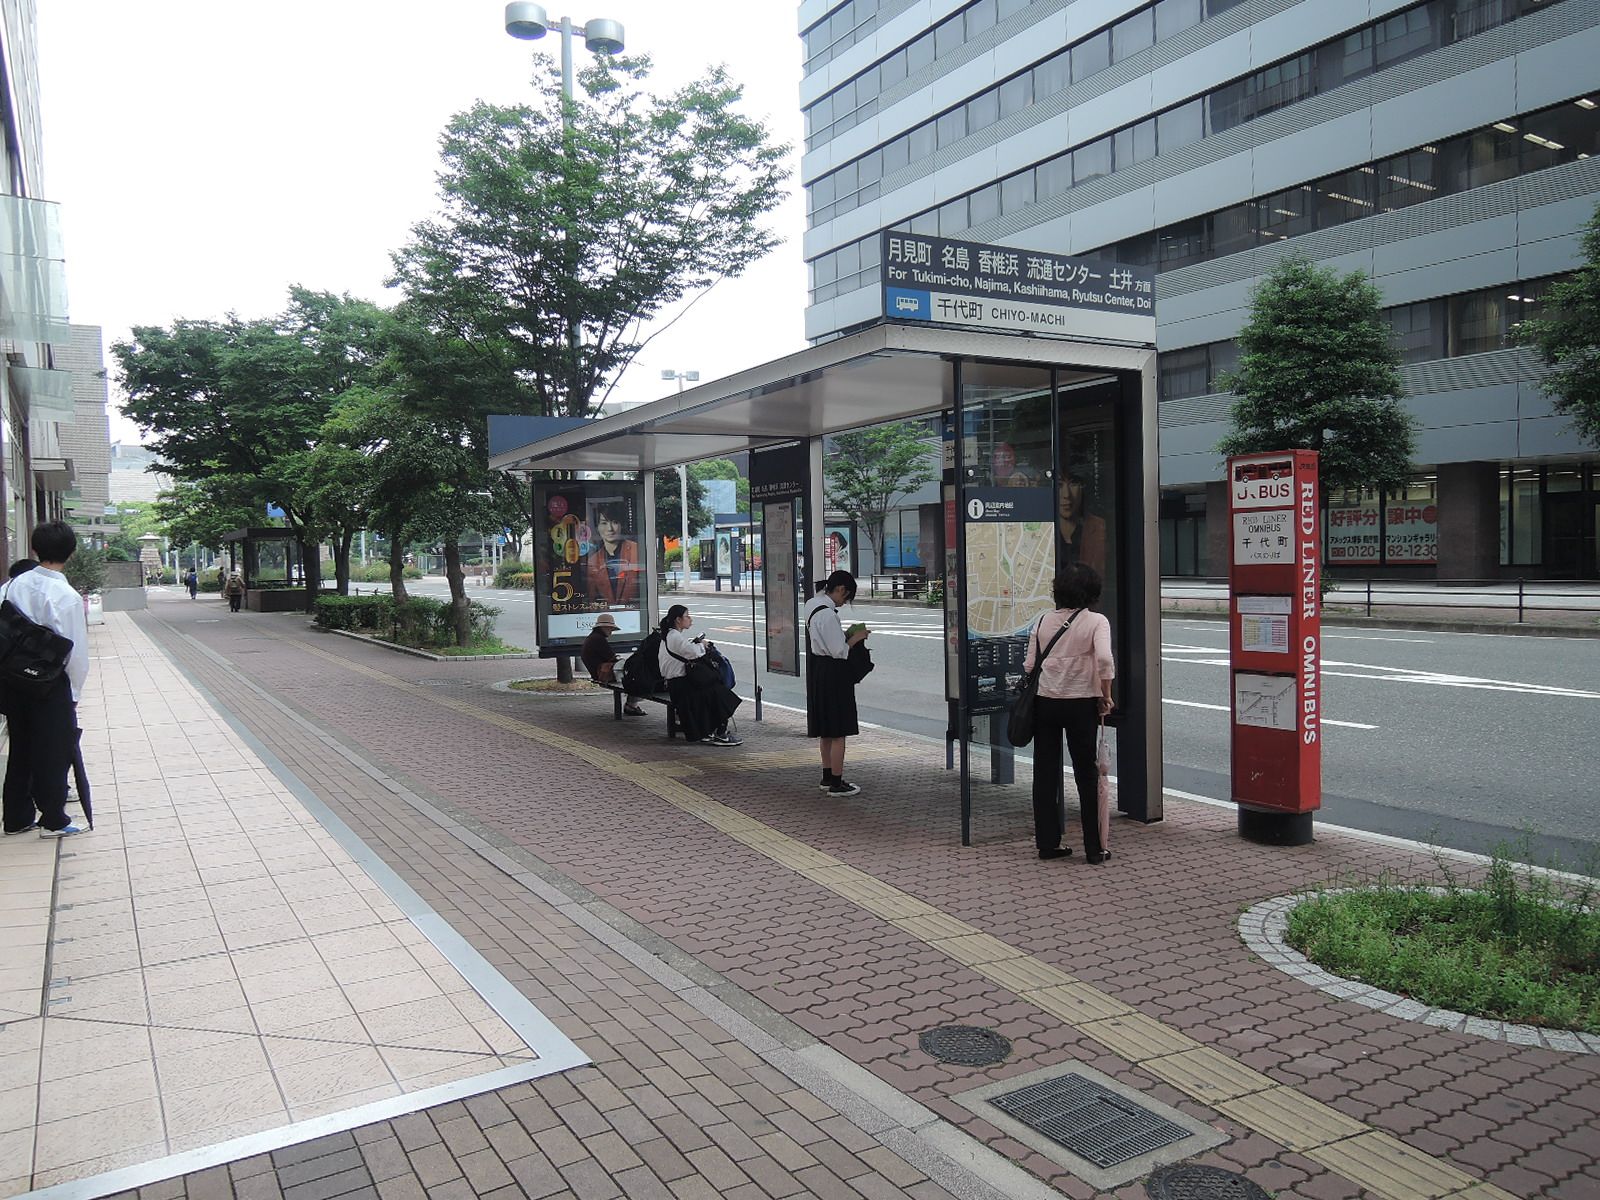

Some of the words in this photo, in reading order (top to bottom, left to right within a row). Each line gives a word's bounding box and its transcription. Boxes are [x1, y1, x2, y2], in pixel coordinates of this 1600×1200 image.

[889, 238, 932, 266] 月見町
[941, 245, 970, 272] 名島
[978, 250, 1019, 277] 香椎浜
[1027, 256, 1102, 285] 流通センター
[1109, 268, 1133, 292] 土井
[1134, 280, 1151, 293] 方面
[888, 266, 907, 280] For
[912, 269, 972, 290] Tukimi-cho,
[975, 278, 1012, 294] Najima,
[1072, 288, 1103, 304] Ryutsu
[1104, 293, 1135, 309] Center,
[1137, 297, 1152, 309] Doi
[937, 298, 983, 321] 千代町
[991, 307, 1065, 326] CHIYO-MACHI
[1259, 483, 1290, 499] BUS
[1301, 481, 1314, 535] RED
[1242, 535, 1288, 549] 千代町
[1248, 524, 1281, 534] OMNIBUS
[552, 571, 574, 602] 5
[1302, 540, 1315, 619] LINER
[1303, 636, 1316, 745] OMNIBUS
